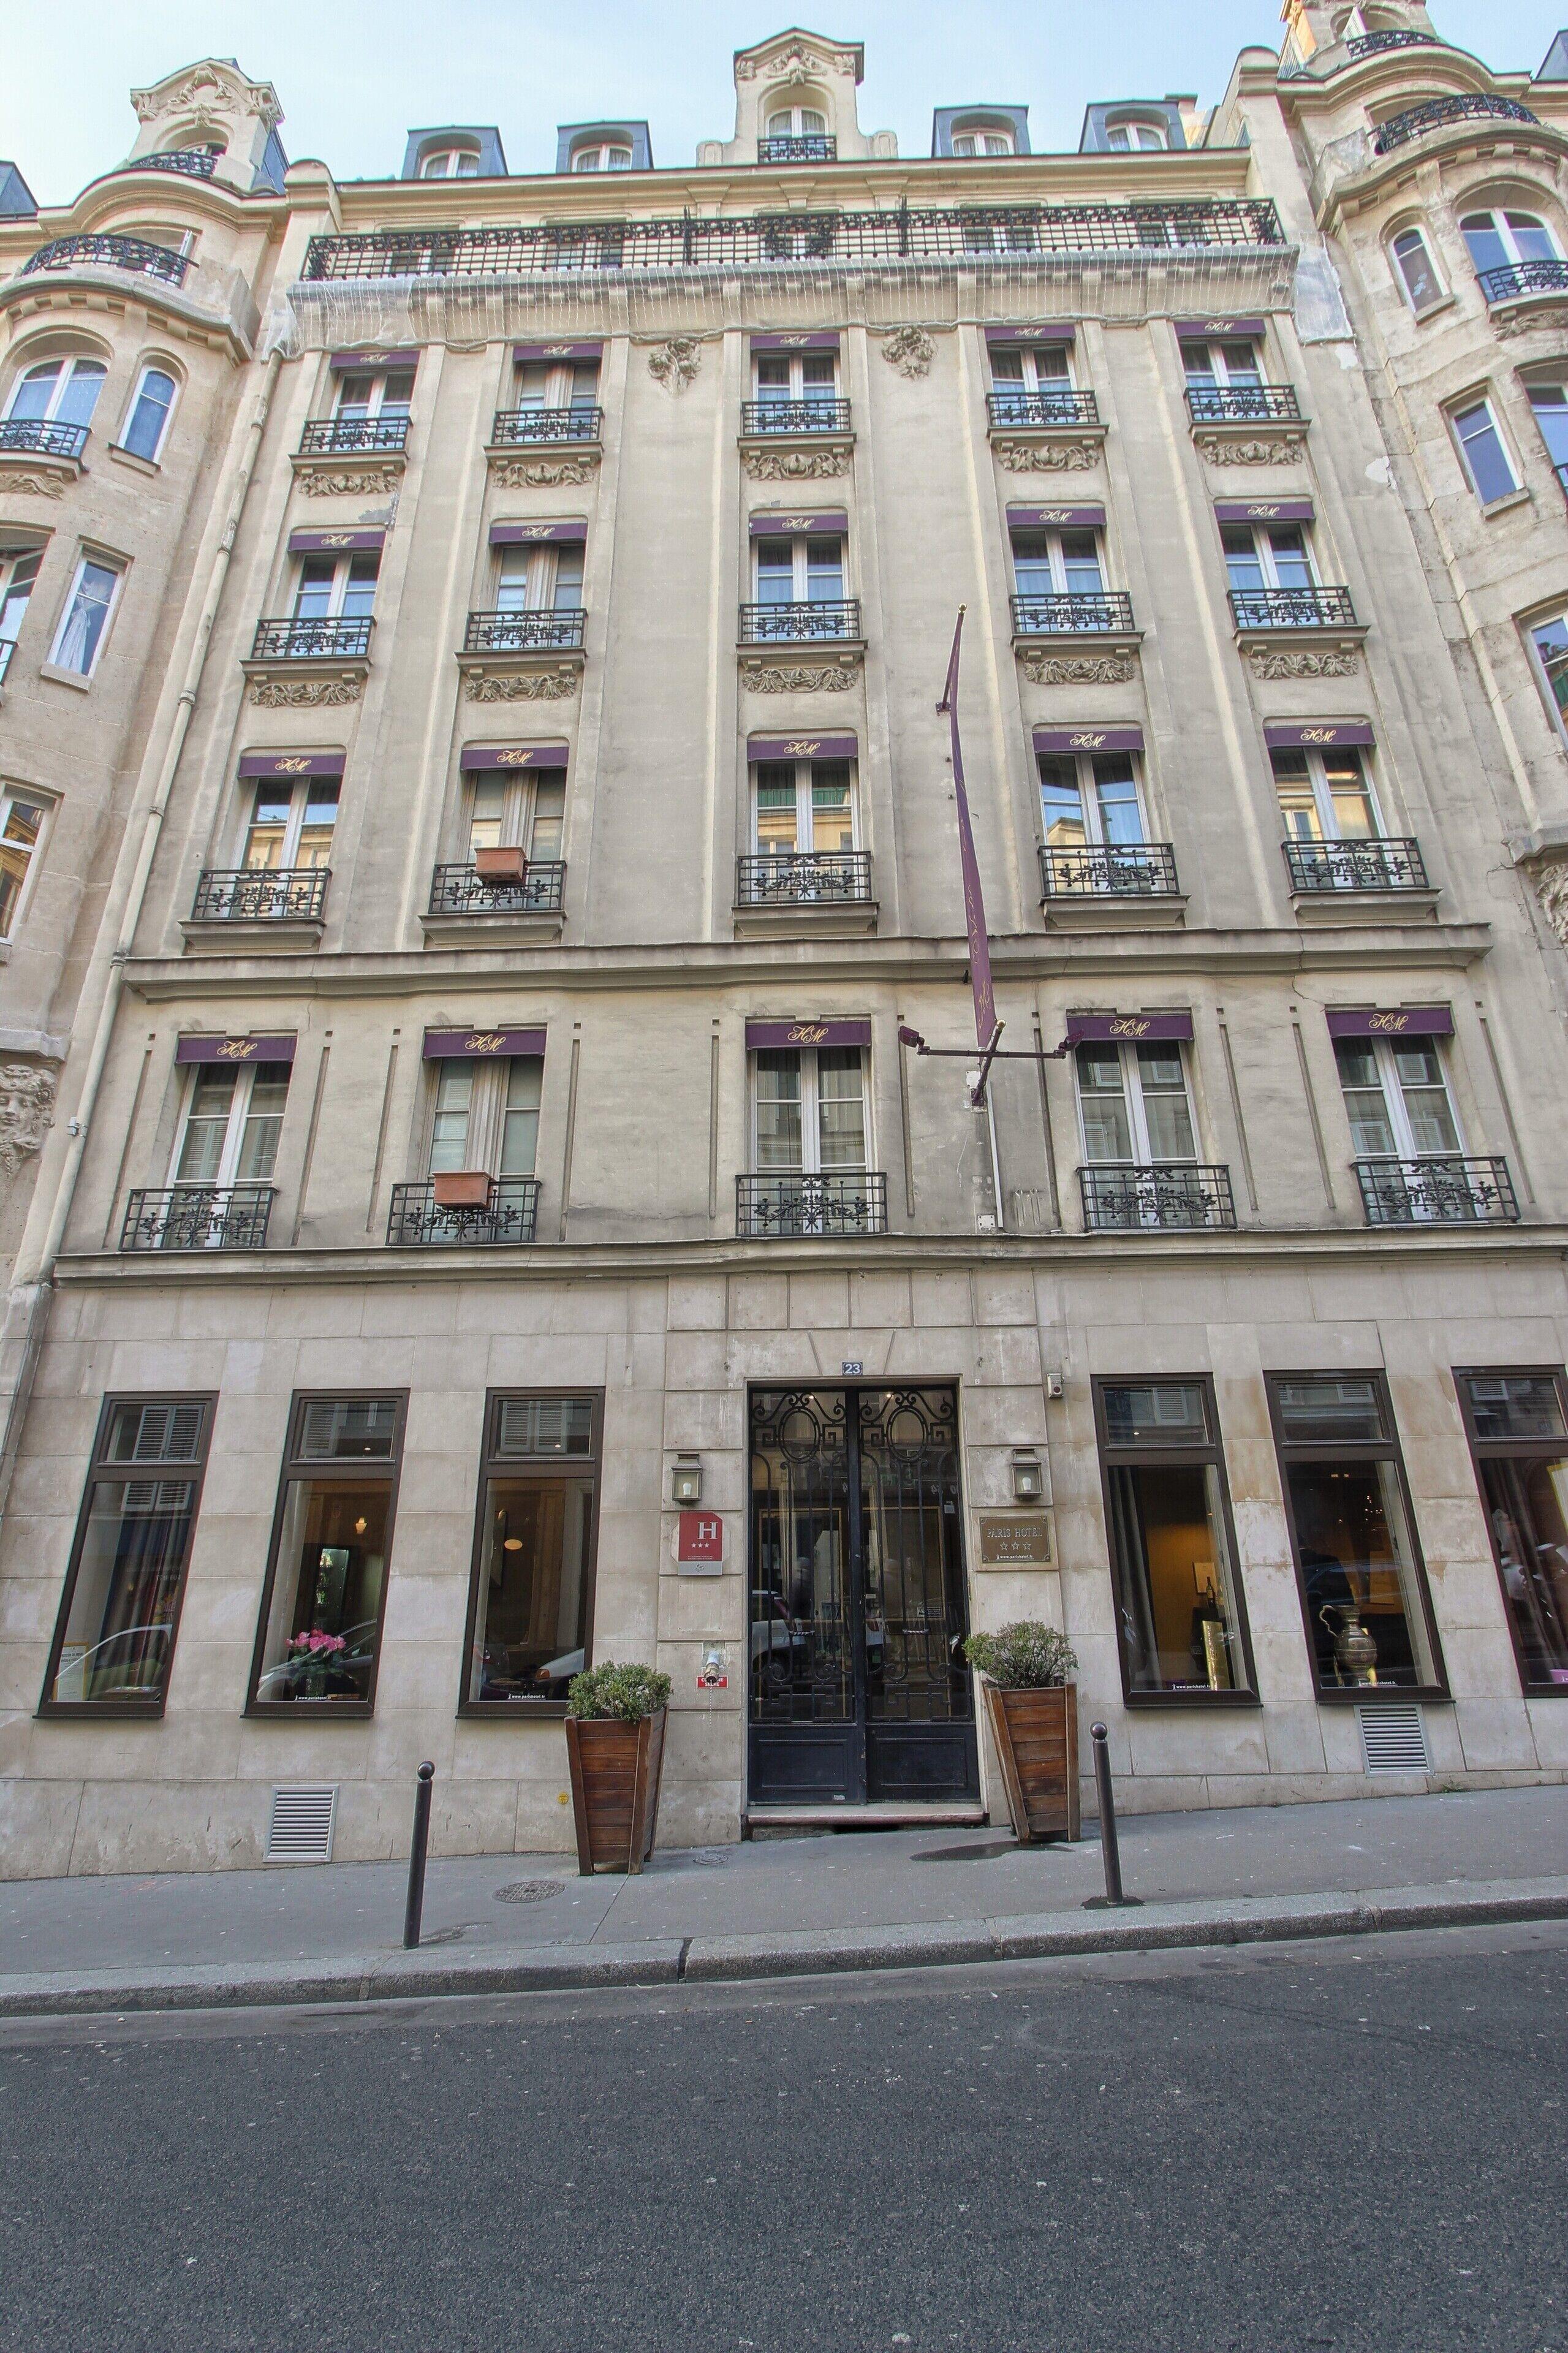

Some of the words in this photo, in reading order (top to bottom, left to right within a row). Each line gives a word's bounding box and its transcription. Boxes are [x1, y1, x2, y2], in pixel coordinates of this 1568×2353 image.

[845, 1364, 860, 1374] 23
[697, 1521, 718, 1540] H
[986, 1528, 1011, 1537] PARIS
[1014, 1527, 1043, 1537] HOTEL
